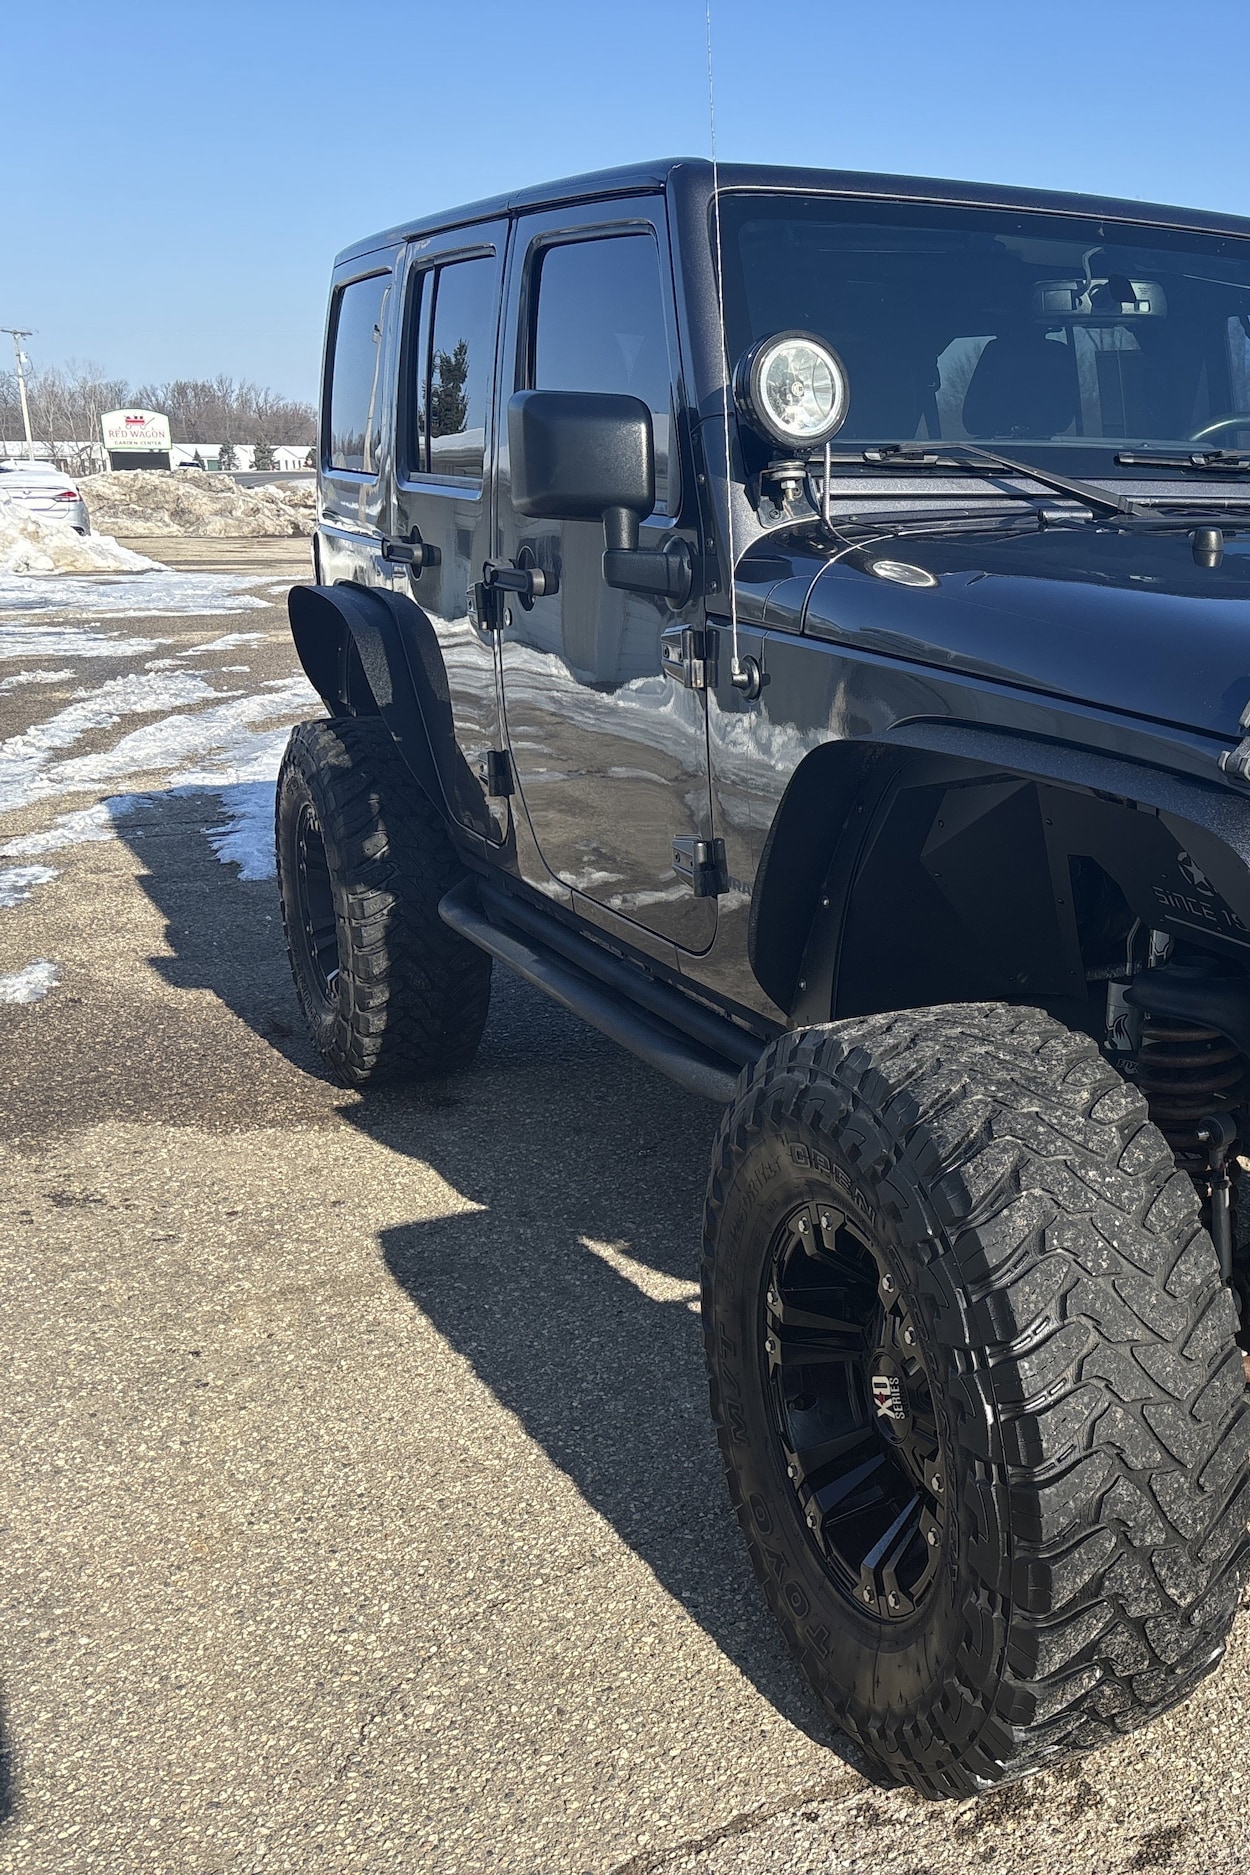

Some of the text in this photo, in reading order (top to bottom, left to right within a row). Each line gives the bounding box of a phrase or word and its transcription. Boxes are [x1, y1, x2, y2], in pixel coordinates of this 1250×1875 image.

[108, 430, 166, 438] RED WAGON
[1221, 909, 1250, 932] 19
[788, 1142, 878, 1229] OPEN
[890, 1377, 906, 1420] SERIES
[749, 1492, 830, 1660] TOYO
